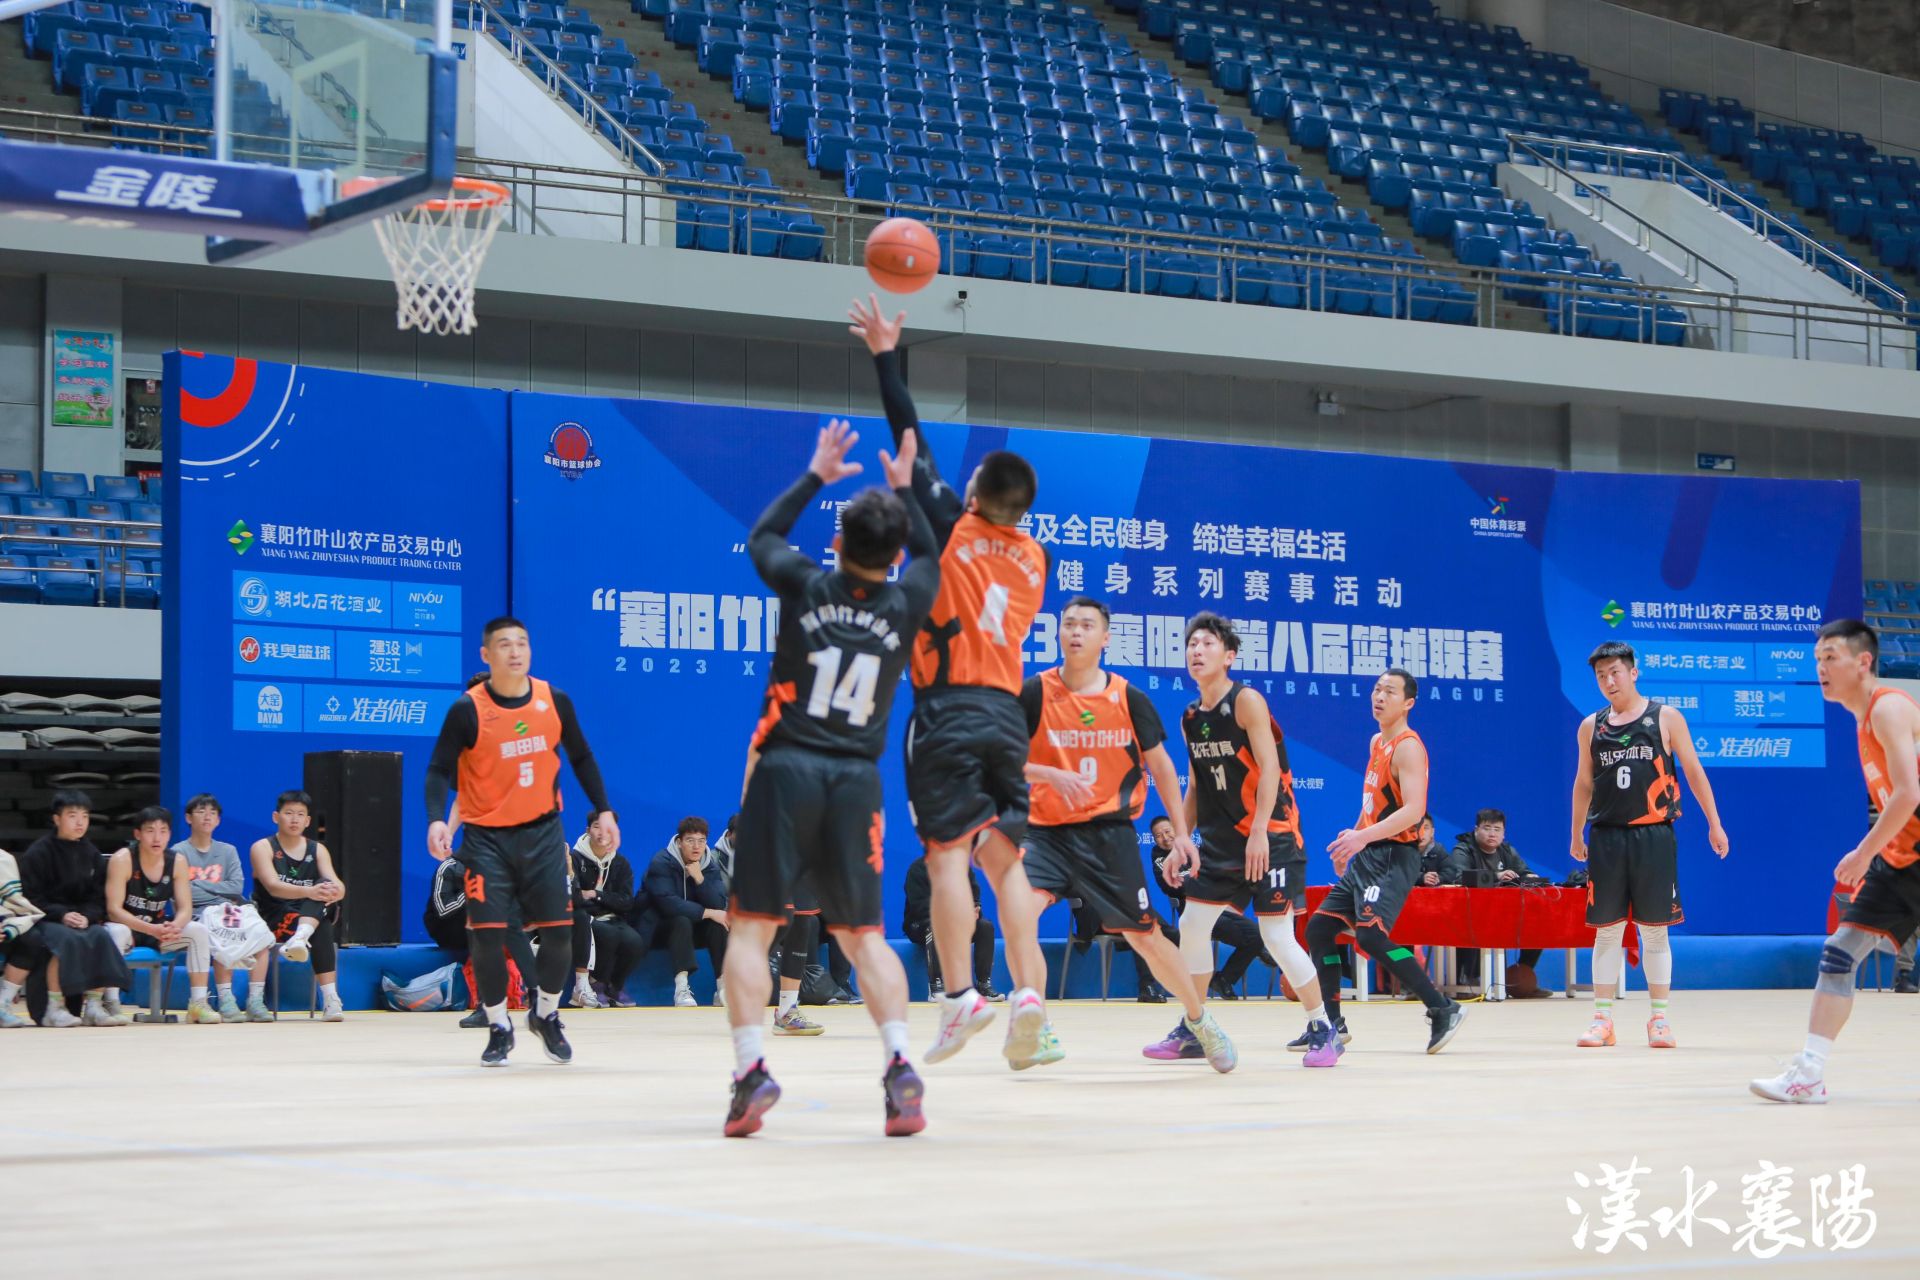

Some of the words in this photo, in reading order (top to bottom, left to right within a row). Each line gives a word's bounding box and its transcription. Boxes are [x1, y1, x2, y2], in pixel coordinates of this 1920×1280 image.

[55, 165, 242, 218] 金陵
[544, 454, 602, 469] 襄阳市篮球协会
[1470, 517, 1527, 532] 中国体育彩票
[260, 523, 463, 558] 襄阳竹叶山农产品交易中心
[1192, 521, 1347, 562] 缔造幸福生活
[261, 547, 286, 559] XIANG
[288, 549, 310, 560] YANG
[312, 552, 360, 564] ZHUYESHAN
[361, 556, 398, 567] PRODUCE
[399, 558, 432, 569] TRADING
[434, 560, 462, 571] CENTER
[274, 590, 383, 614] 湖北石花酒业
[1630, 601, 1822, 622] 襄阳竹叶山农产品交易中心
[592, 588, 780, 653] “襄阳竹
[978, 581, 1009, 647] 4
[1632, 620, 1655, 629] XIANG
[1656, 621, 1677, 630] YANG
[1678, 621, 1724, 631] ZHUYESHAN
[1725, 622, 1759, 631] PRODUCE
[1761, 623, 1793, 632] TRADING
[263, 642, 331, 661] 我奥篮球
[369, 639, 401, 656] 建设
[369, 657, 401, 673] 汉江
[615, 656, 707, 675] 2023
[1644, 654, 1746, 670] 湖北石花酒业
[806, 645, 881, 727] 14
[1734, 690, 1765, 704] 建设
[260, 693, 280, 707] 大窑
[349, 697, 428, 724] 准者体育
[1734, 704, 1765, 718] 汉江
[1717, 737, 1792, 758] 准者体育
[519, 761, 534, 788] 5
[1079, 756, 1097, 785] 9
[1616, 765, 1631, 789] 6
[1267, 867, 1286, 889] 11
[1137, 887, 1149, 910] 9
